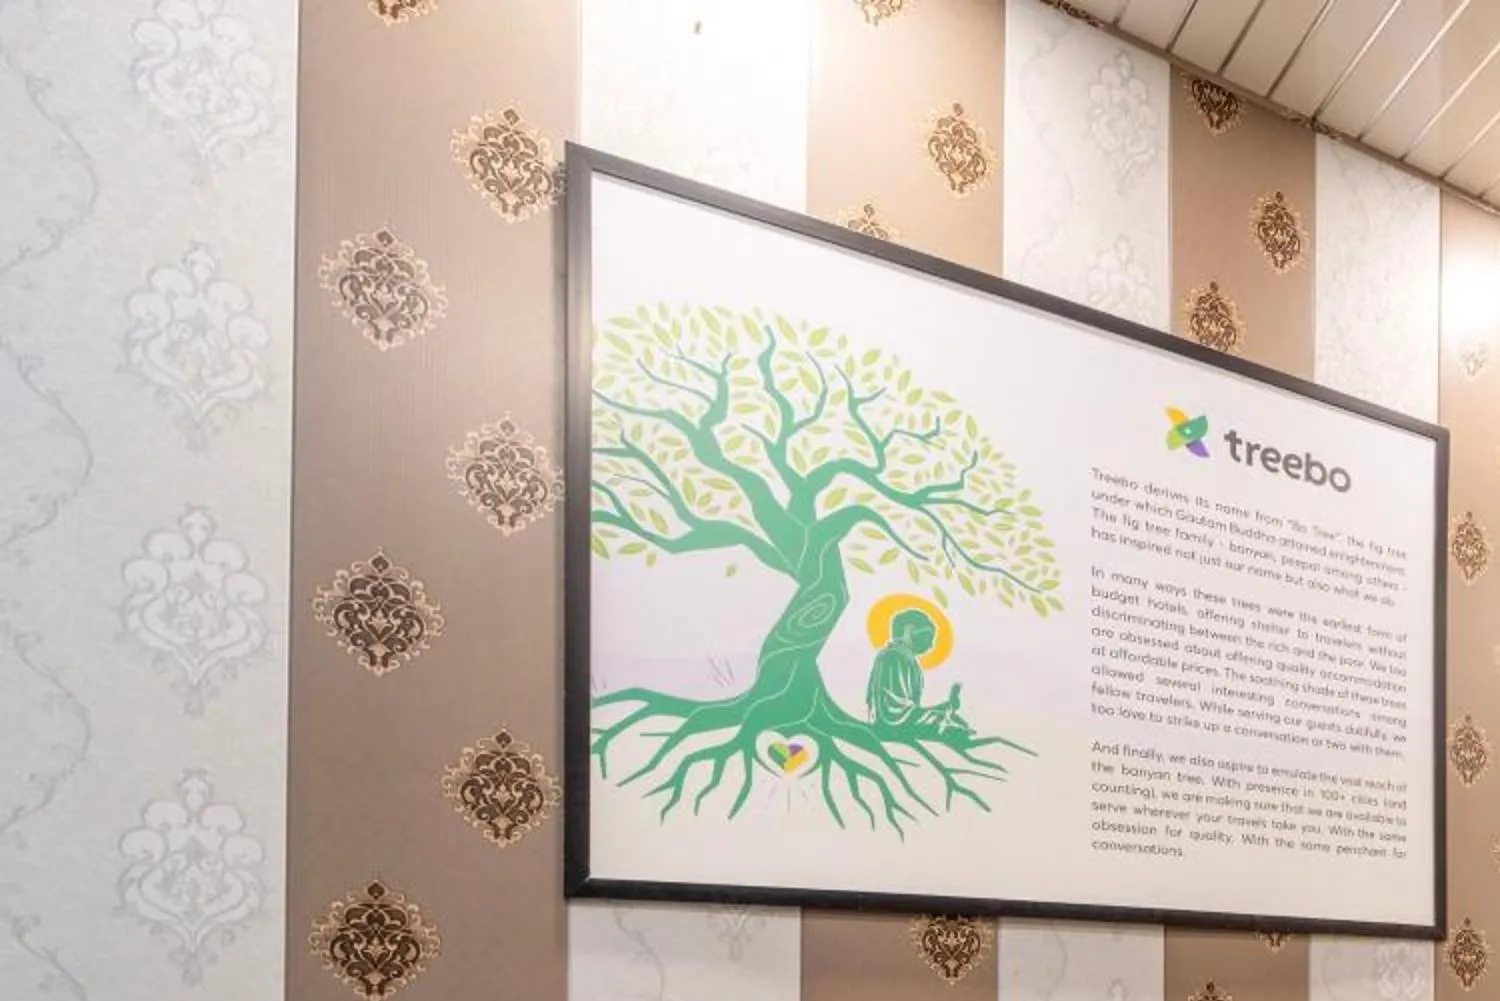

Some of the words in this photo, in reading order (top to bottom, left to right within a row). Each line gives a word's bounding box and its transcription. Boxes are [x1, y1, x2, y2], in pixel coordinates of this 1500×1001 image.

[1223, 429, 1352, 493] treebo
[1090, 490, 1130, 509] under
[1134, 500, 1172, 519] which
[1175, 508, 1226, 532] Gautam
[1143, 481, 1189, 504] derives
[1195, 494, 1209, 509] its
[1215, 502, 1249, 519] name
[1255, 509, 1283, 527] from
[1092, 507, 1116, 524] The
[1122, 514, 1139, 532] fig
[1145, 520, 1170, 537] tree
[1175, 526, 1214, 550] family
[1090, 526, 1116, 544] has
[1119, 532, 1171, 556] inspired
[1174, 548, 1195, 561] not
[1199, 551, 1221, 567] just
[1224, 559, 1244, 572] our
[1247, 564, 1281, 580] name
[1285, 570, 1303, 585] but
[1307, 577, 1330, 591] also
[1332, 583, 1359, 598] what
[1091, 584, 1139, 606] budget
[1196, 607, 1244, 629] offering
[1110, 572, 1148, 591] many
[1154, 581, 1186, 598] ways
[1193, 587, 1226, 604] these
[1231, 595, 1261, 612] trees
[1090, 604, 1185, 636] discriminating
[1189, 622, 1241, 644] between
[1245, 634, 1264, 648] the
[1292, 645, 1314, 657] and
[1091, 626, 1114, 639] are
[1118, 630, 1179, 651] obsessed
[1183, 641, 1221, 658] about
[1225, 649, 1272, 670] offering
[1276, 660, 1315, 678] quality
[1090, 663, 1145, 683] allowed
[1154, 675, 1201, 692] several
[1211, 682, 1274, 706] interesting
[1109, 647, 1177, 669] affordable
[1224, 666, 1246, 681] The
[1091, 681, 1131, 700] fellow
[1199, 698, 1234, 715] While
[1237, 707, 1280, 725] serving
[1283, 714, 1302, 725] our
[1090, 702, 1115, 716] too
[1118, 705, 1145, 721] love
[1166, 714, 1200, 728] strike
[1233, 725, 1309, 744] conversation
[1325, 737, 1346, 749] two
[1349, 740, 1372, 753] with
[1090, 760, 1114, 774] the
[1121, 763, 1170, 781] banyan
[1211, 774, 1240, 789] With
[1245, 781, 1298, 795] presence
[1091, 740, 1119, 755] And
[1189, 753, 1214, 767] also
[1217, 759, 1254, 773] aspire
[1319, 770, 1338, 783] the
[1090, 801, 1126, 814] serve
[1132, 803, 1190, 820] wherever
[1195, 812, 1223, 824] your
[1227, 813, 1266, 827] travels
[1271, 818, 1296, 830] take
[1327, 823, 1354, 836] With
[1357, 826, 1374, 838] the
[1378, 831, 1406, 841] same
[1182, 792, 1203, 803] are
[1205, 794, 1250, 810] making
[1253, 800, 1278, 811] sure
[1280, 800, 1304, 814] that
[1325, 808, 1342, 818] are
[1091, 818, 1156, 835] obsession
[1164, 824, 1182, 838] for
[1241, 832, 1268, 846] With
[1274, 835, 1294, 848] the
[1300, 840, 1330, 851] same
